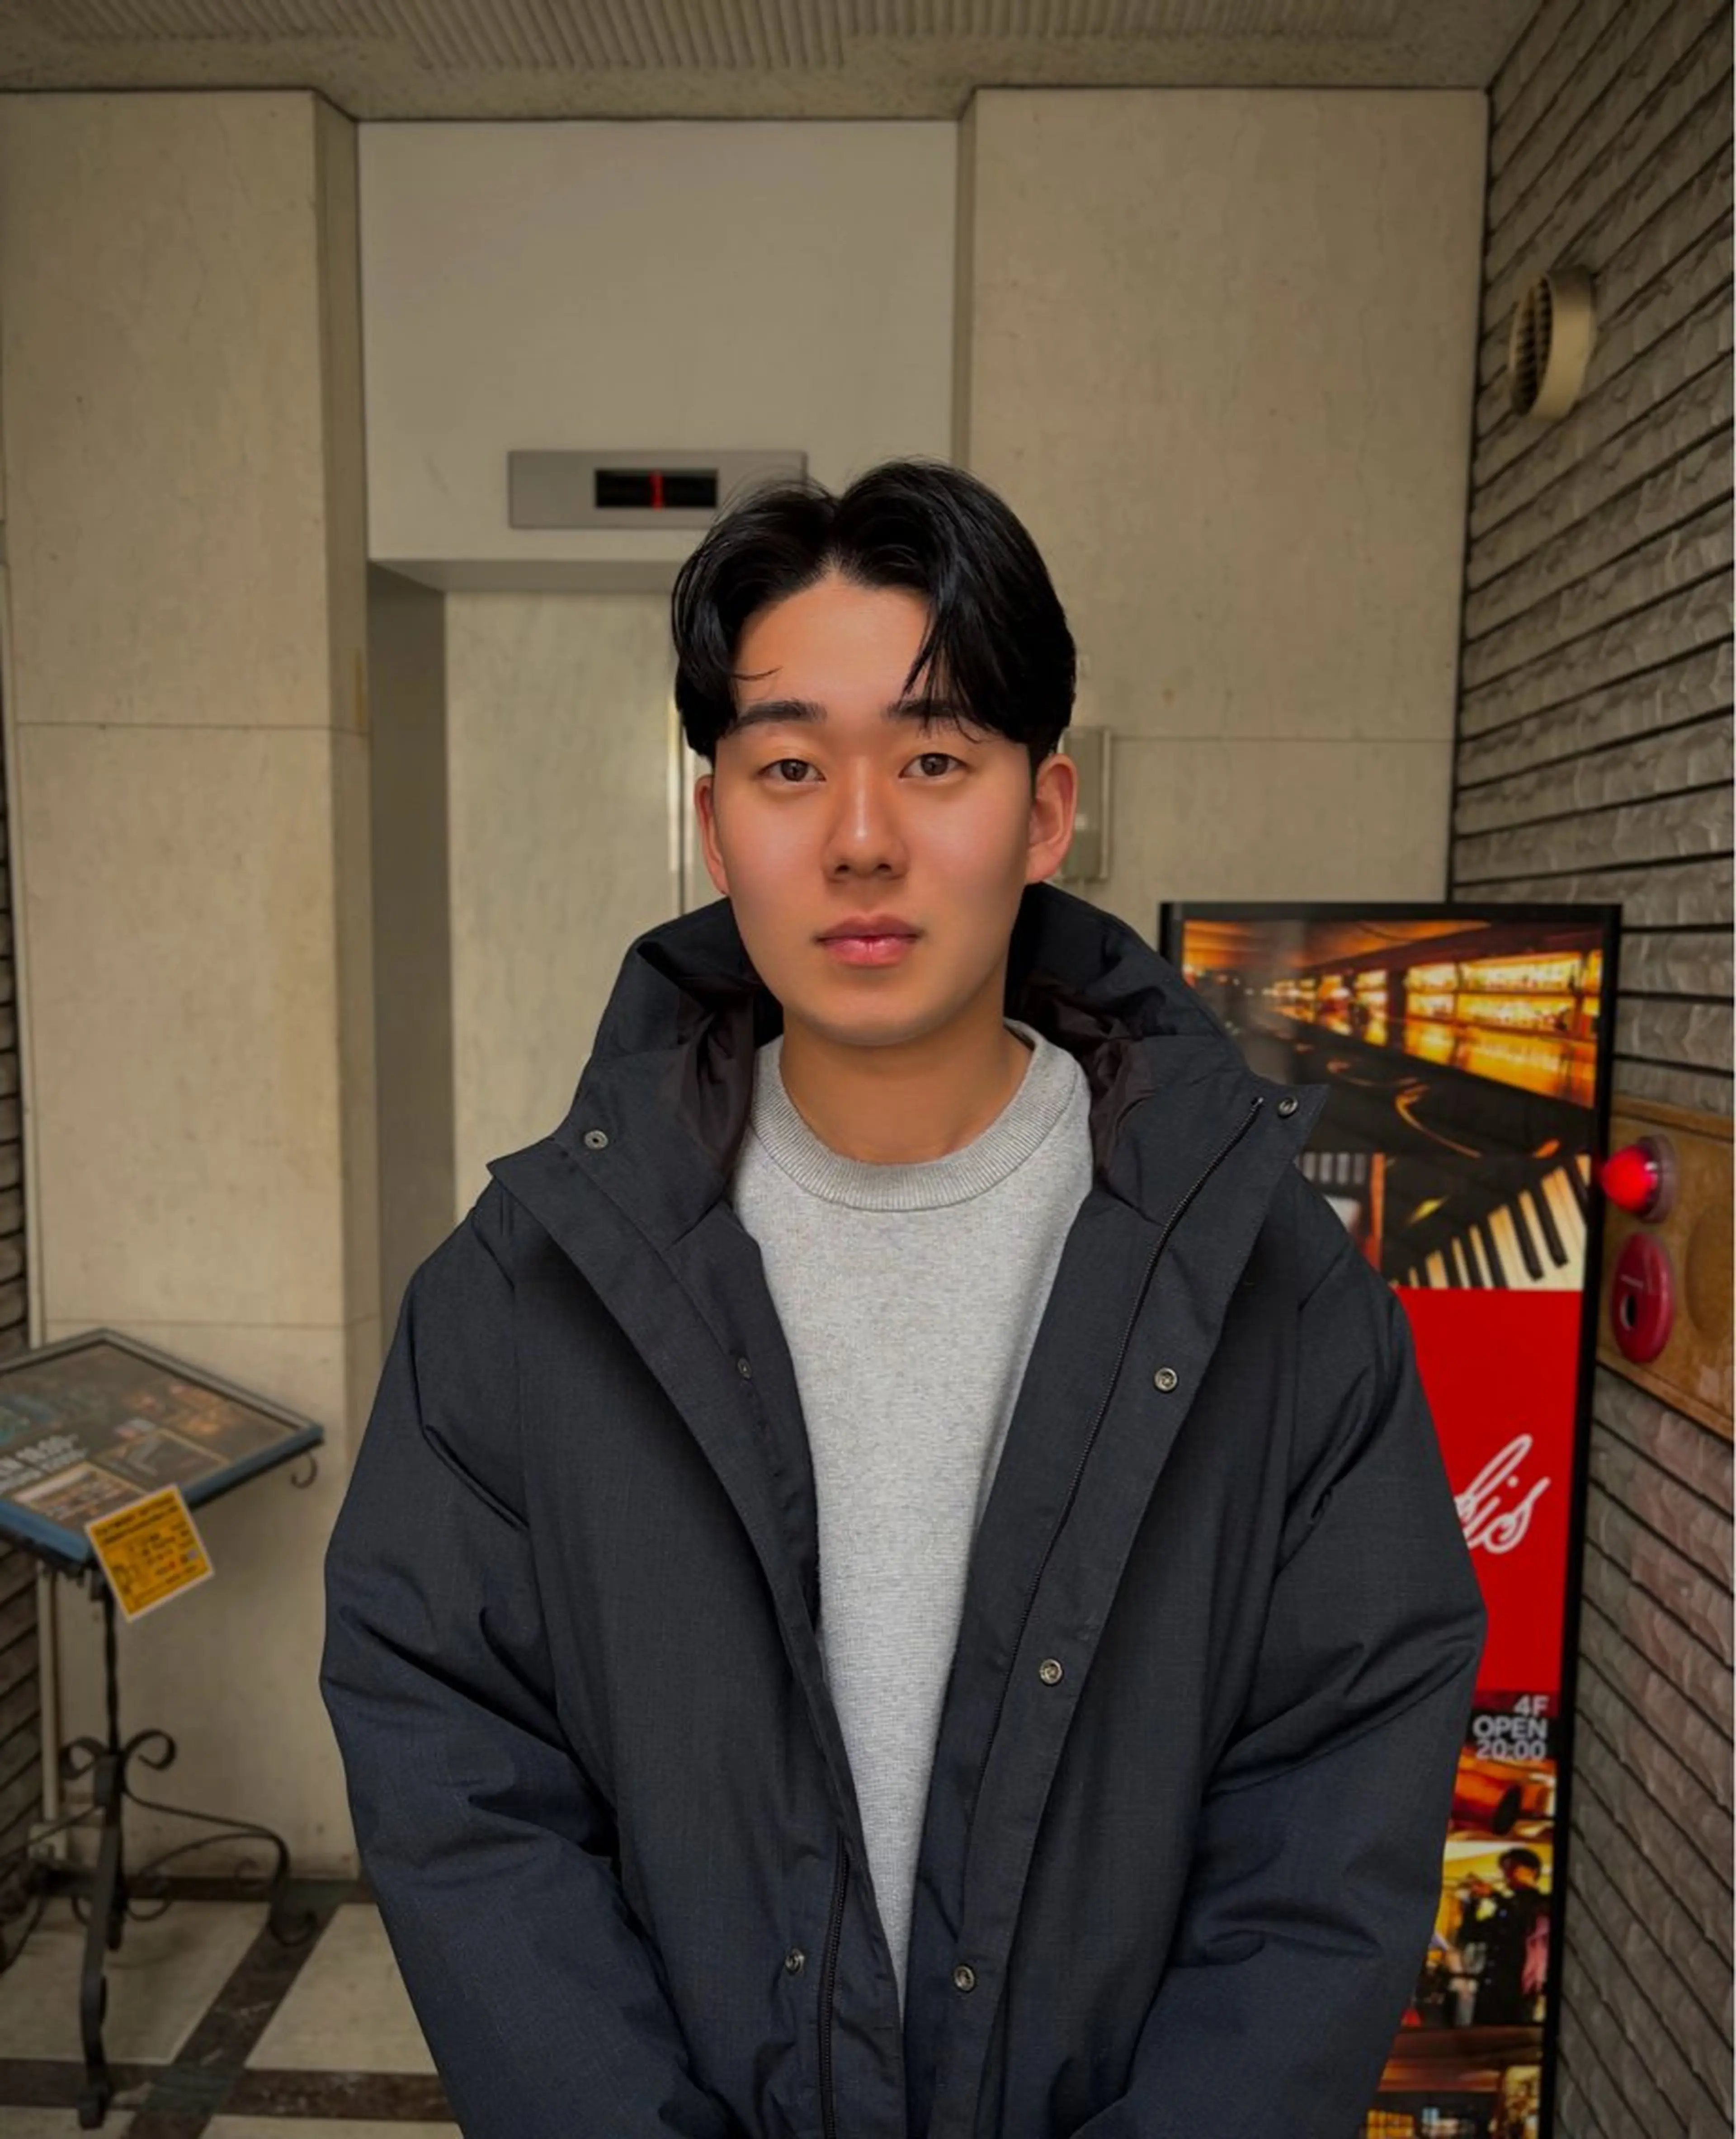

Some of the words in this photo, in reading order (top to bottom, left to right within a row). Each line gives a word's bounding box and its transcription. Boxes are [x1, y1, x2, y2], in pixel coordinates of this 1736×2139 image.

[1514, 1695, 1550, 1717] 4F
[1472, 1715, 1547, 1739] OPEN
[1476, 1740, 1546, 1761] 20:00
